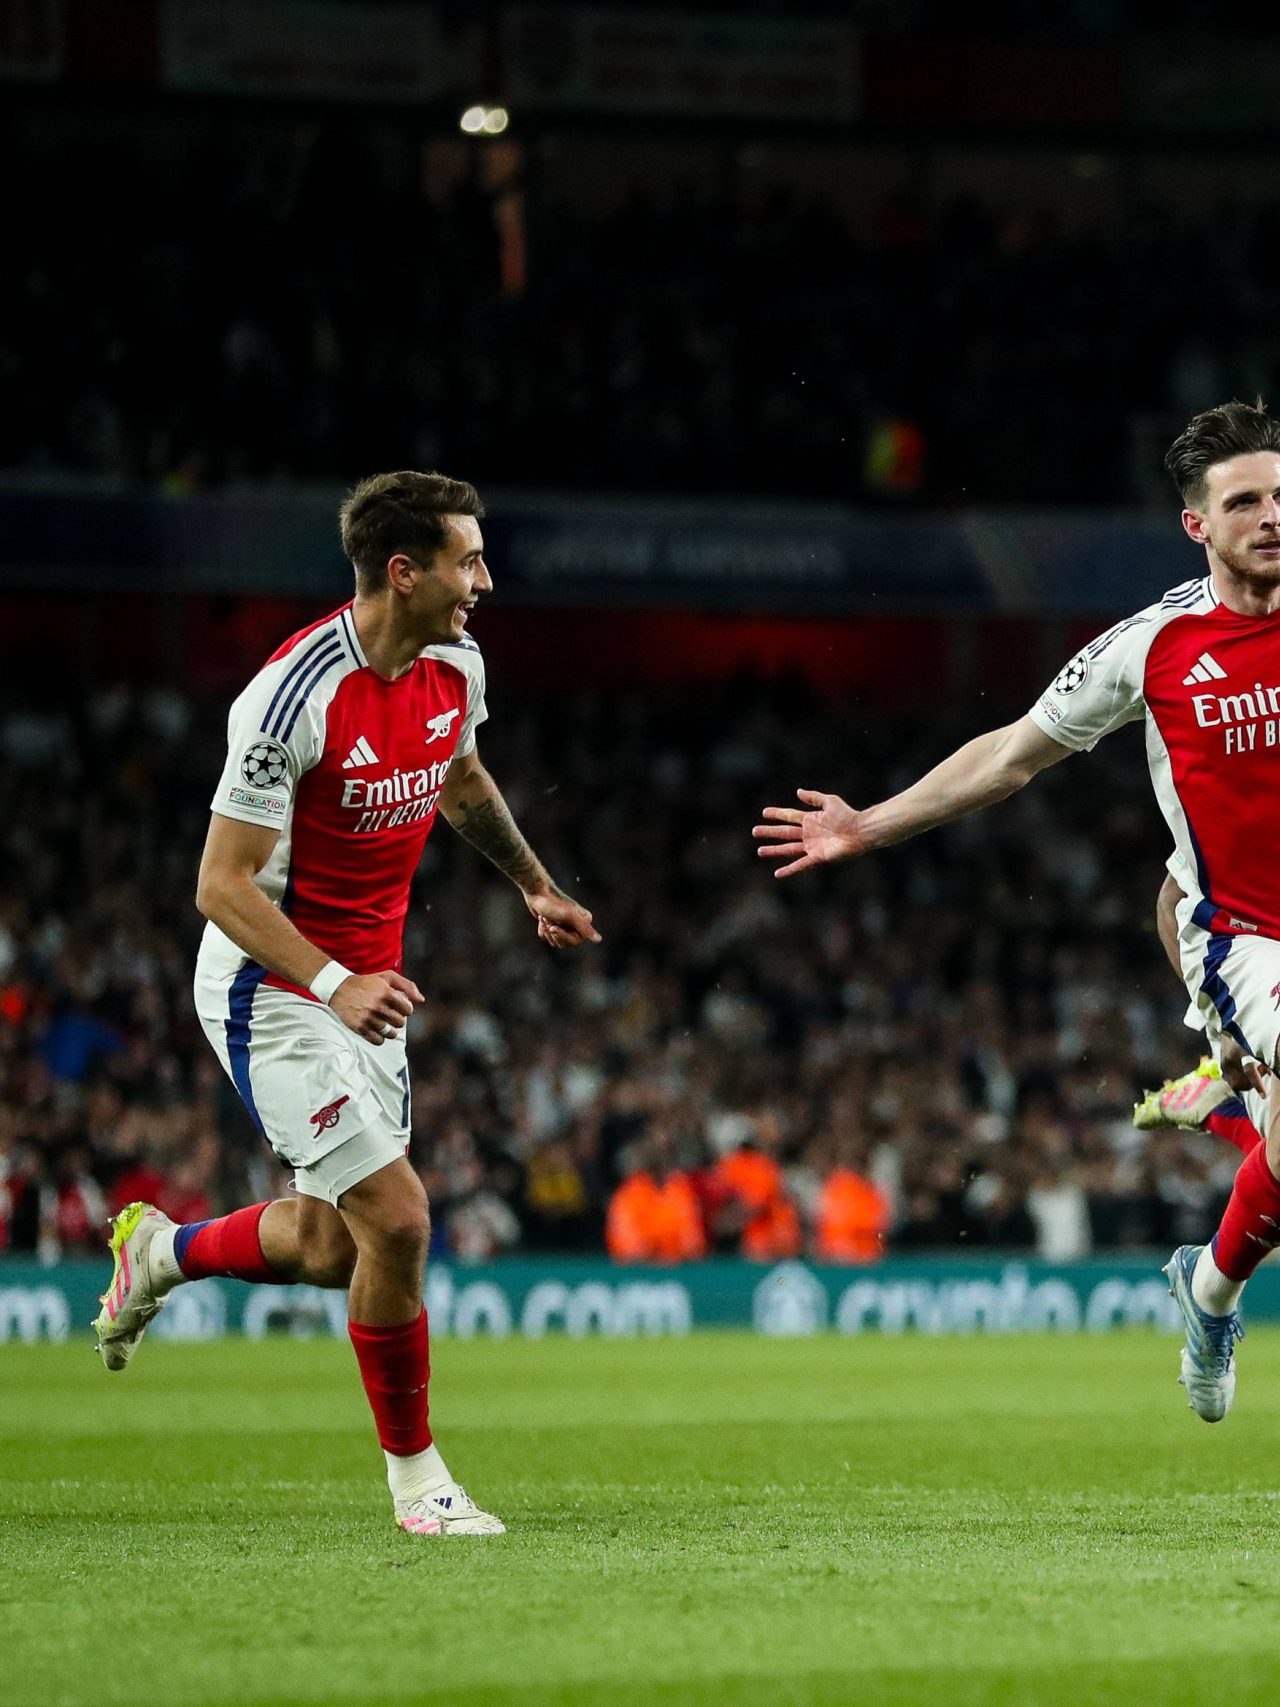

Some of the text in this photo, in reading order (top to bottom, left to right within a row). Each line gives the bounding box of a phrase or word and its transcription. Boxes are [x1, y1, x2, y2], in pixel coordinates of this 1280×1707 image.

[1225, 723, 1257, 755] FLY
[229, 791, 286, 810] FOUNDATION
[353, 809, 391, 833] FLY
